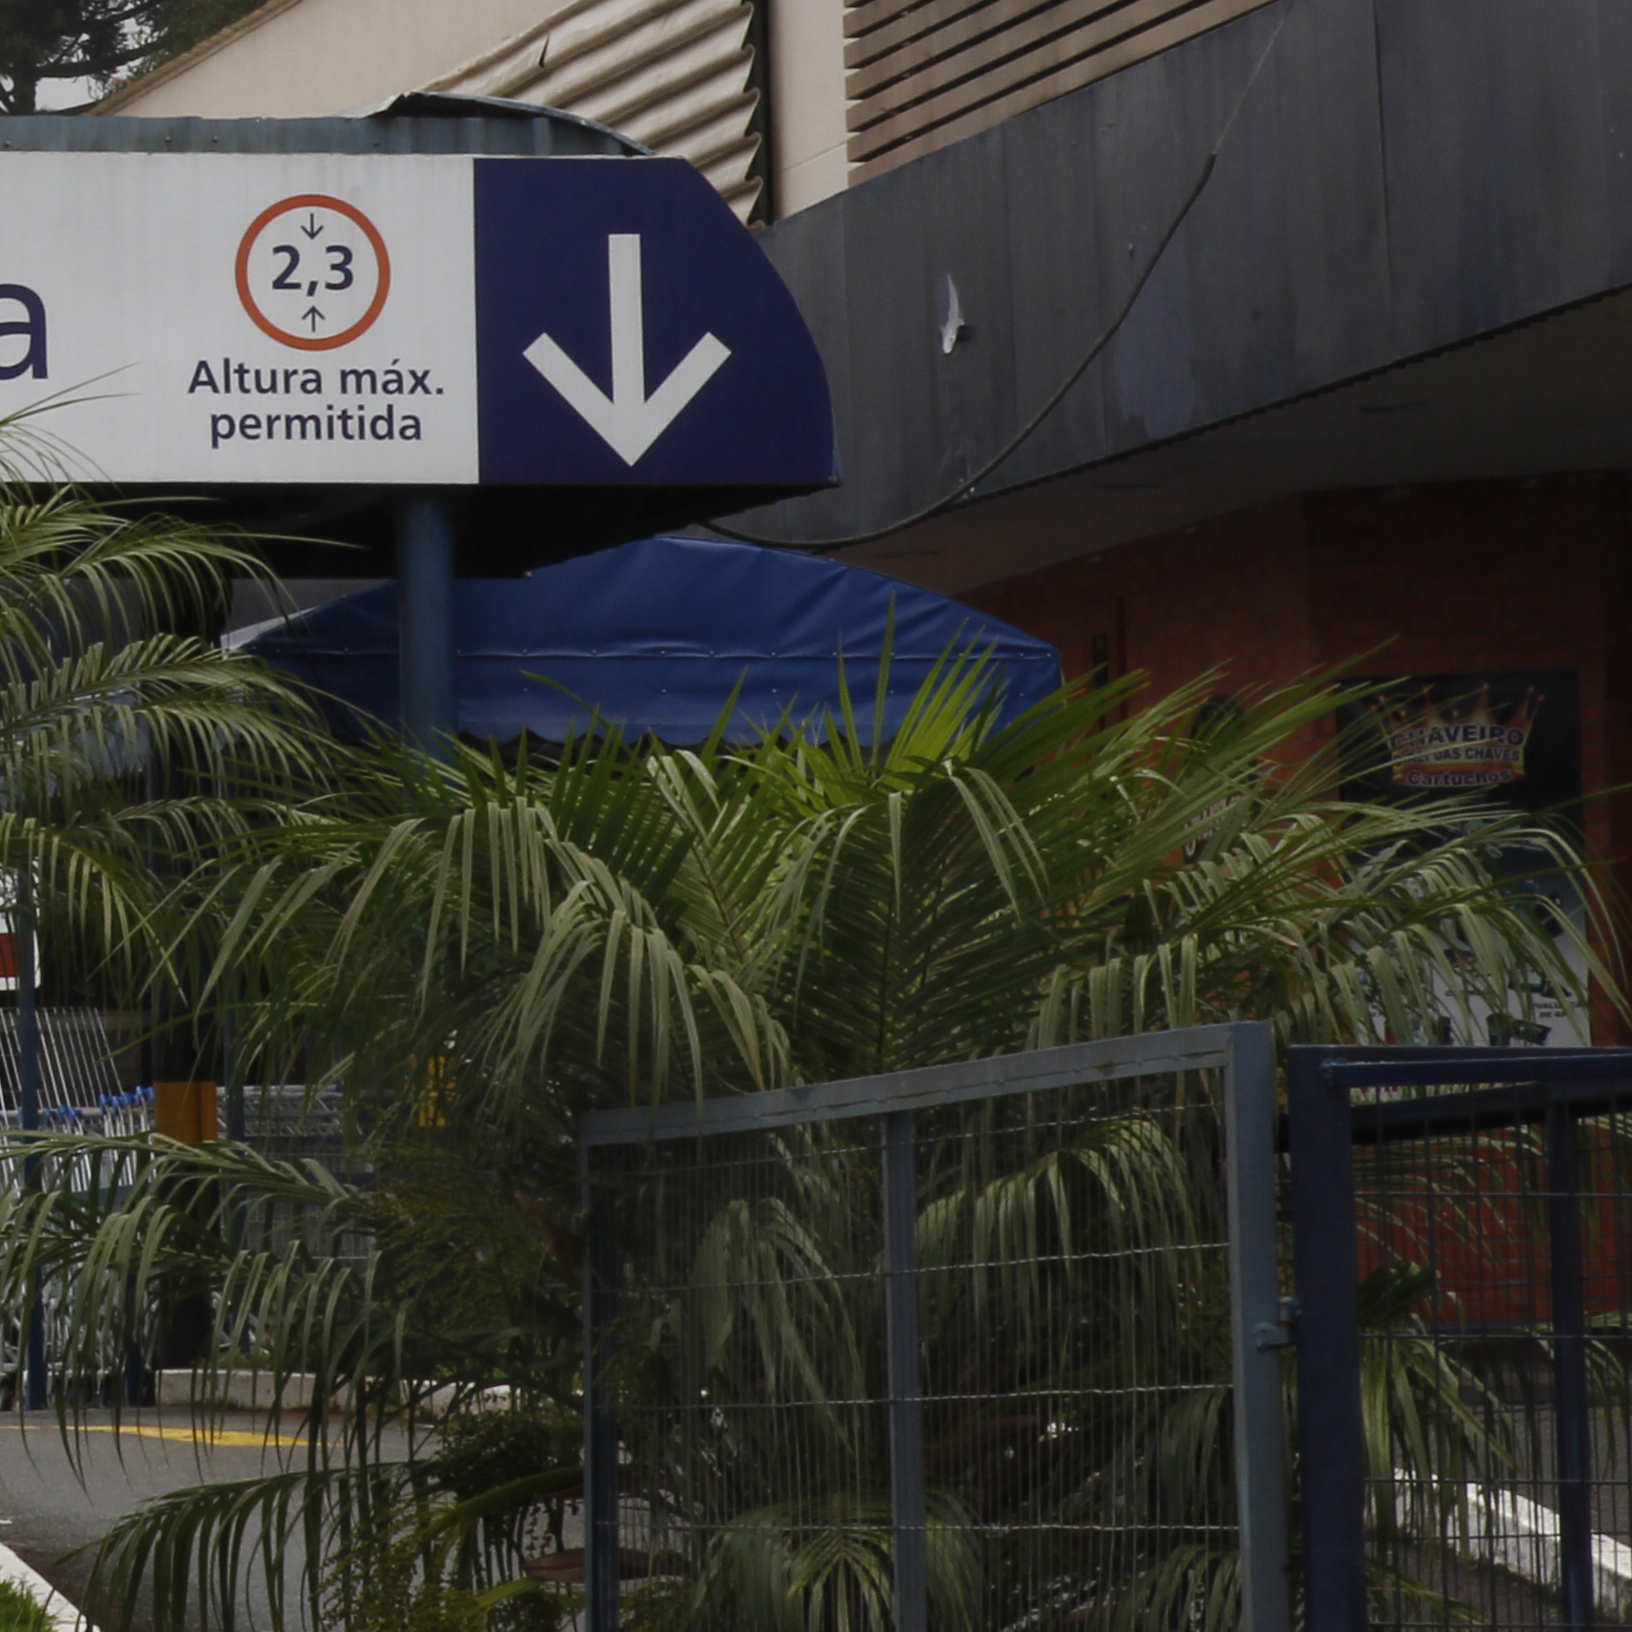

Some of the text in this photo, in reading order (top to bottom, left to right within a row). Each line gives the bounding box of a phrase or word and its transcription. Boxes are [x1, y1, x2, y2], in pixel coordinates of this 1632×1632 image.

[271, 244, 354, 297] 2,3
[187, 358, 445, 396] Altura máx.
[210, 404, 422, 450] permitida
[1465, 747, 1520, 762] CHAVES
[1407, 770, 1511, 786] Cartuchos
